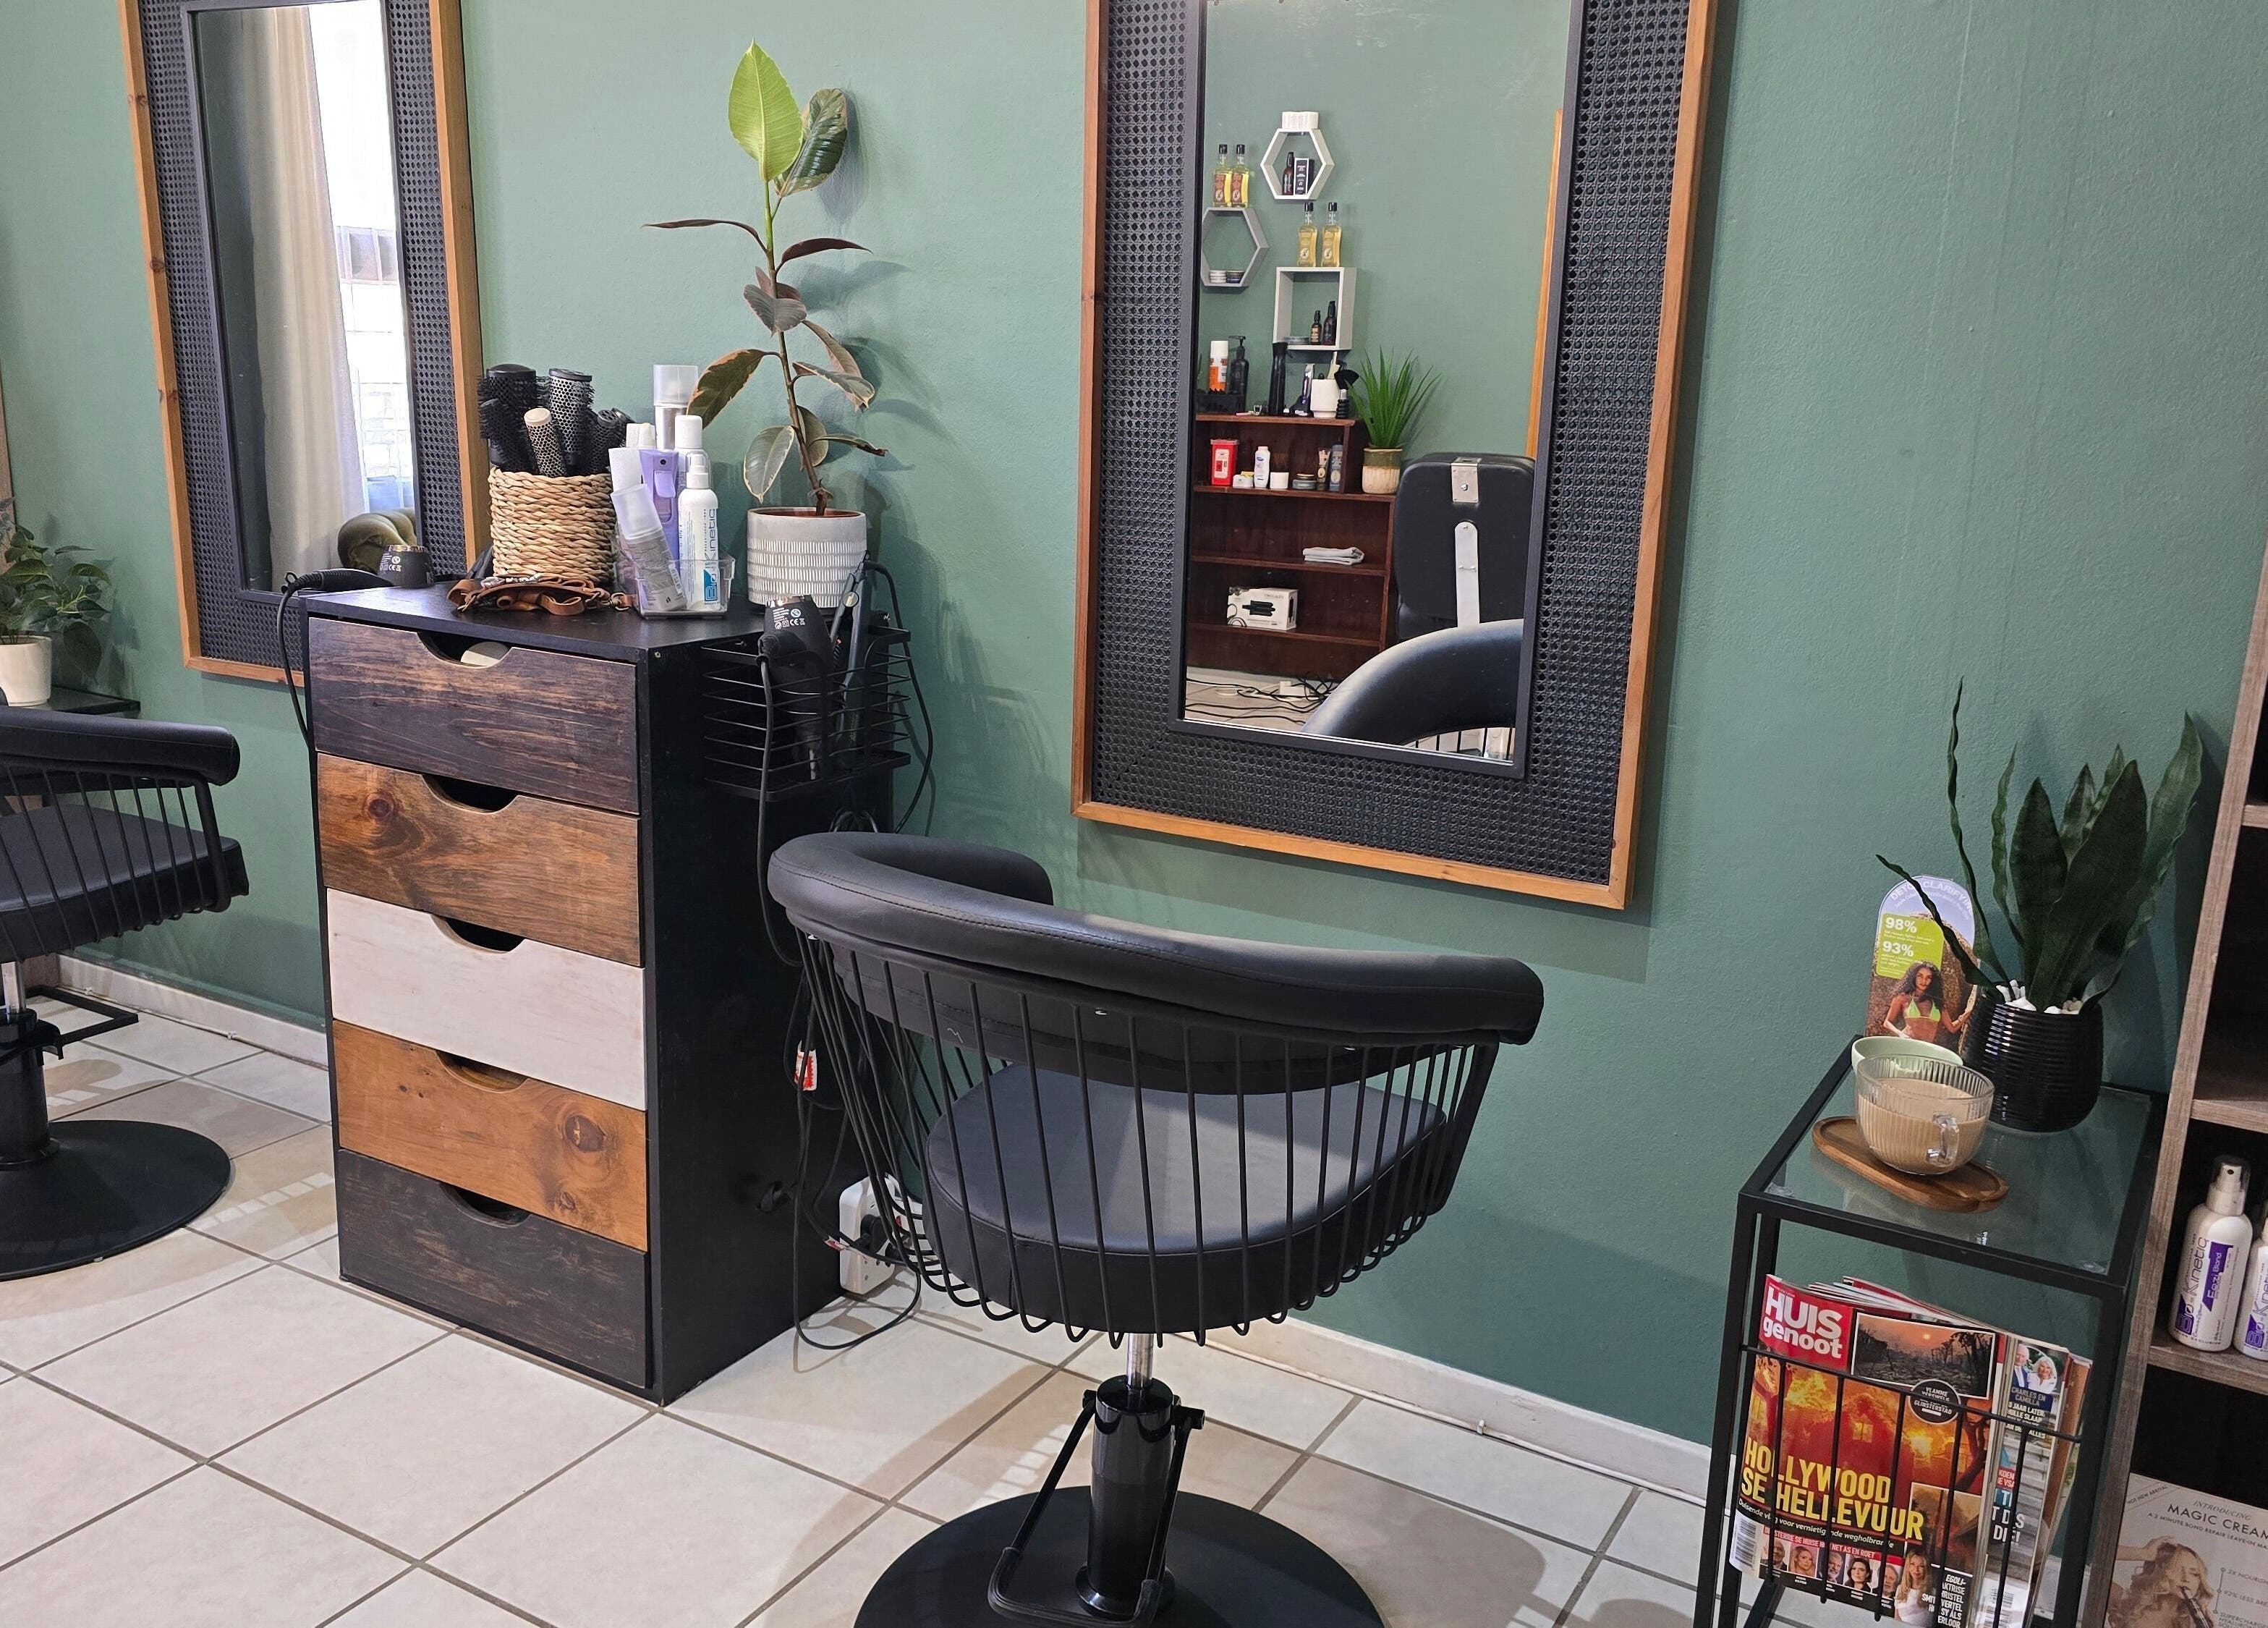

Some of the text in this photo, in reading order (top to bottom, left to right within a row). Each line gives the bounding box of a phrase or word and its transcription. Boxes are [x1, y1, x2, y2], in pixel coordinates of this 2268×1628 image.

[1890, 881, 1914, 901] DETO
[1885, 917, 1917, 933] 98%
[1882, 941, 1914, 957] 93%
[1765, 1286, 1843, 1339] HUIS
[1763, 1316, 1843, 1359] genoot
[2011, 1386, 2037, 1399] CHARLES
[1741, 1467, 1768, 1504] SE
[2167, 1504, 2218, 1525] MAGIC
[2193, 1500, 2252, 1521] INTRODUCING
[1780, 1518, 1795, 1527] voor
[1796, 1523, 1843, 1537] vernietignde
[2159, 1515, 2183, 1526] MINUTE
[2185, 1522, 2204, 1532] BOND
[2256, 1541, 2268, 1550] MA
[1843, 1545, 1851, 1553] AS
[1941, 1598, 1963, 1612] VERTEL
